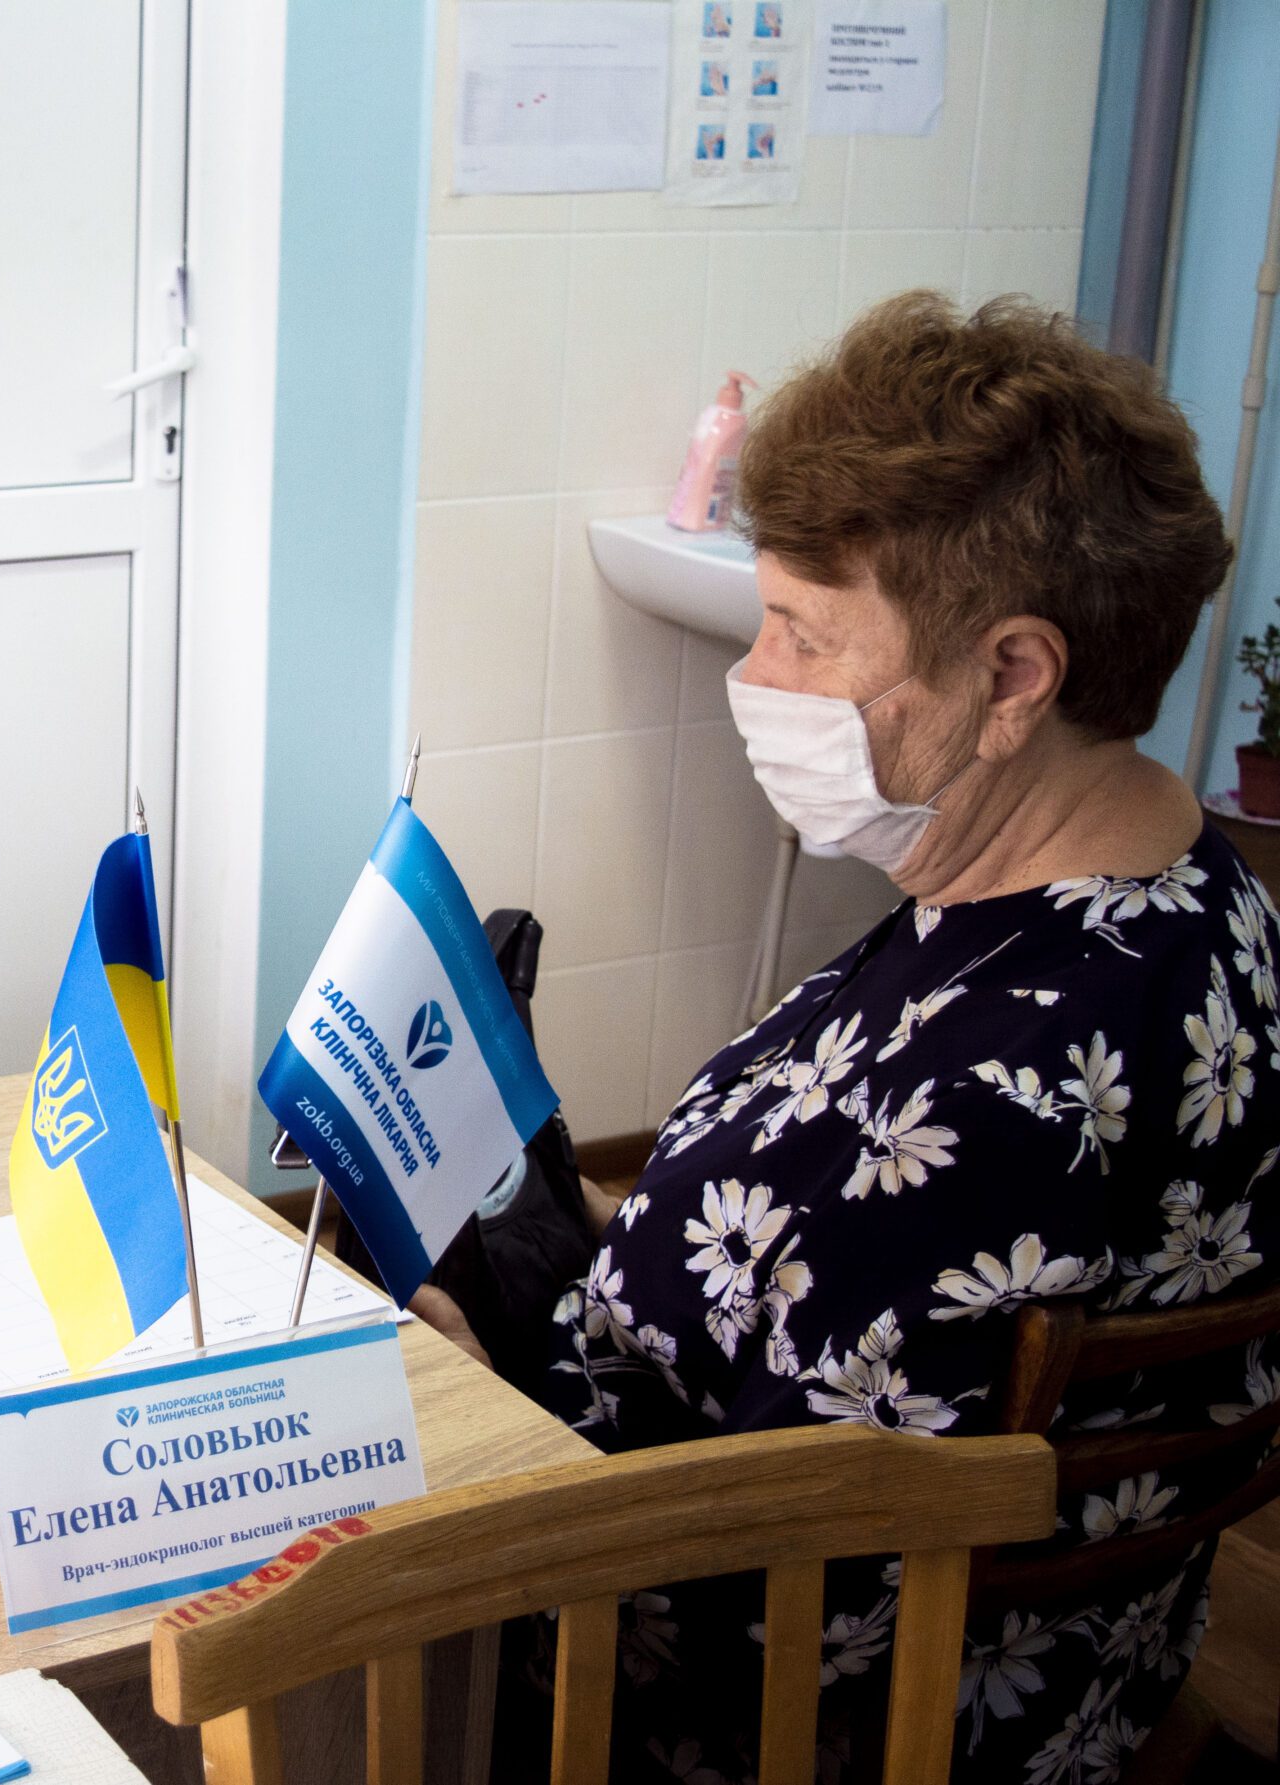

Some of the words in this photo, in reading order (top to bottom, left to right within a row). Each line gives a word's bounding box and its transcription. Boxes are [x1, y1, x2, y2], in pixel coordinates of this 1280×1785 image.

[308, 1016, 383, 1108] КЛІНІЧНА
[372, 1103, 421, 1177] ЛІКАРНЯ
[315, 977, 405, 1094] ЗАПОРІЗЬКА
[391, 1086, 445, 1169] ОБЛАСНА
[294, 1093, 369, 1187] zokb.org.ua
[144, 1389, 222, 1414] ЗАПОРОЖСКАЯ
[224, 1377, 284, 1398] ОБЛАСТНАЯ
[147, 1400, 224, 1425] КЛИНИЧЕСКАЯ
[228, 1388, 285, 1409] БОЛЬНИЦА
[98, 1408, 314, 1481] Соловьюк
[5, 1493, 140, 1547] Елена
[145, 1434, 408, 1518] Анатольевна
[60, 1531, 228, 1584] Врач-эндокринолог
[229, 1514, 295, 1544] высшей
[295, 1497, 377, 1528] категории
